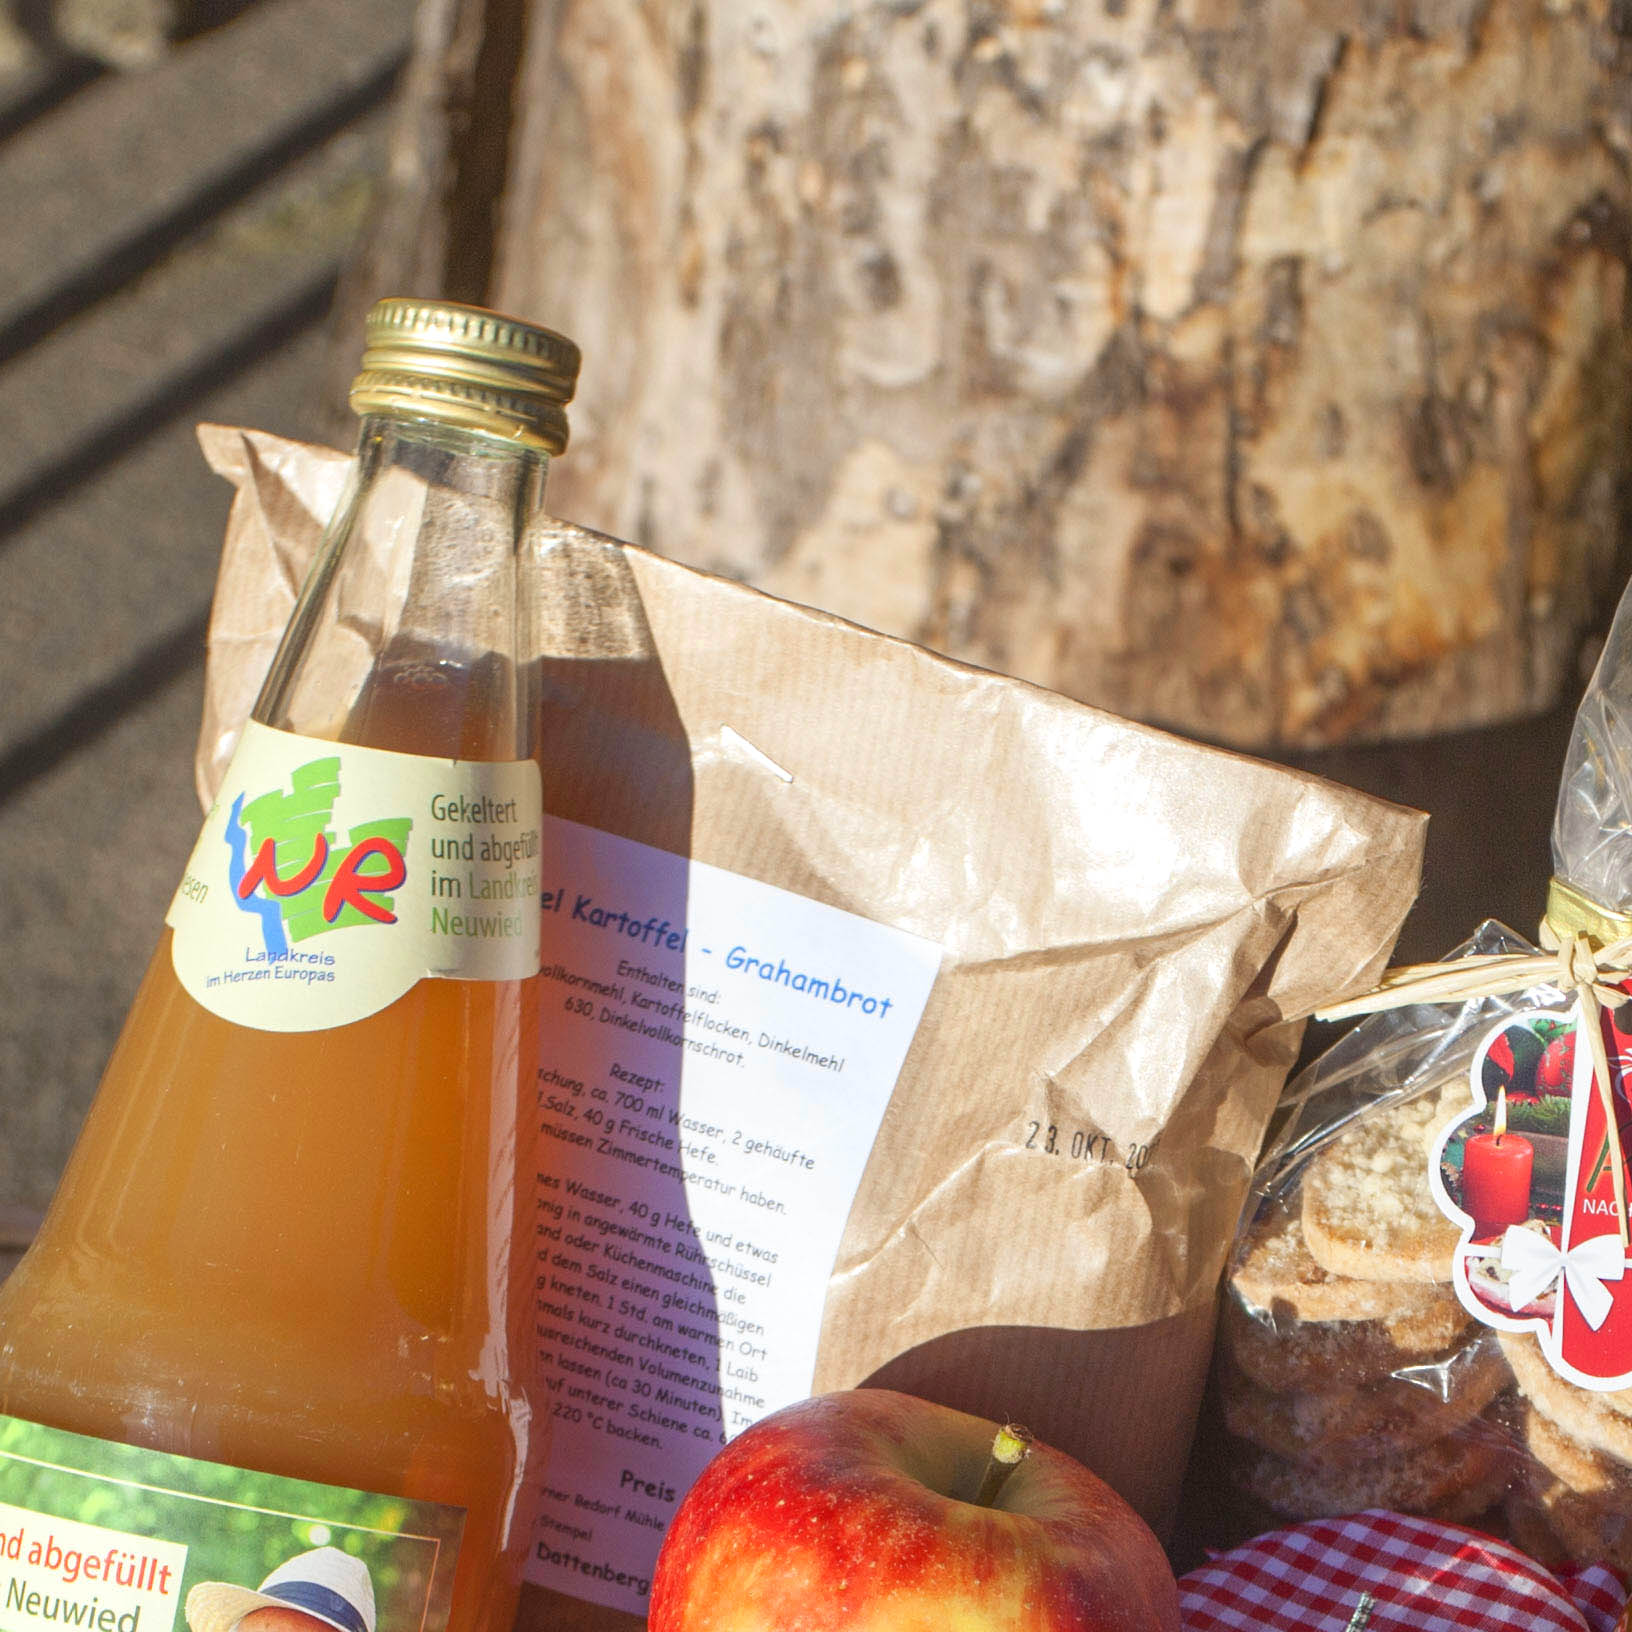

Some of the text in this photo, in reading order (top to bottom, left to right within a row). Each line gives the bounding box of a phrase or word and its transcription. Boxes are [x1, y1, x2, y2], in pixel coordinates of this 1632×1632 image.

[431, 794, 519, 824] Gekeltert
[431, 832, 474, 862] und
[431, 869, 461, 898] im
[431, 906, 523, 938] Neuwied
[206, 965, 336, 988] im Herzen Europas
[245, 946, 336, 966] Landkreis
[572, 894, 894, 1019] Kartoffel Grahambrot
[617, 960, 722, 1005] Enthalten sind:
[564, 996, 595, 1021] 630,
[630, 990, 753, 1046] Kartoffelflocken,
[757, 1030, 846, 1074] Dinkelmehl
[609, 1062, 665, 1094] Rezept:
[582, 1107, 604, 1127] 40
[605, 1118, 616, 1134] g
[618, 1118, 674, 1151] Frische
[615, 1091, 644, 1114] 700
[645, 1104, 666, 1121] ml
[731, 1130, 743, 1147] 2
[746, 1137, 816, 1172] gehäufte
[596, 1136, 737, 1197] Zimmertemperatur
[740, 1187, 788, 1216] haben.
[567, 1205, 581, 1221] in
[584, 1211, 672, 1255] angewärmte
[628, 1200, 649, 1219] 40
[651, 1210, 662, 1227] g
[664, 1211, 702, 1239] Hefe
[705, 1230, 734, 1248] und
[735, 1239, 779, 1265] etwas
[564, 1229, 747, 1305] oder Küchenmaschine die
[551, 1252, 583, 1274] dem
[586, 1261, 618, 1286] Salz
[621, 1277, 660, 1301] einen
[662, 1291, 765, 1336] gleichmäßigen
[578, 1307, 610, 1334] kurz
[726, 1361, 759, 1383] Laib
[618, 1300, 648, 1323] Std.
[652, 1314, 674, 1332] am
[677, 1324, 735, 1353] warmen
[739, 1340, 769, 1361] Ort
[557, 1353, 602, 1382] lassen
[631, 1379, 652, 1397] 30
[638, 1355, 766, 1409] Volumenzunahme
[552, 1401, 583, 1424] 220
[606, 1418, 664, 1450] backen.
[568, 1384, 625, 1412] unterer
[627, 1403, 689, 1435] Schiene
[619, 1468, 677, 1503] Preis
[624, 1508, 666, 1533] Mühle
[27, 1534, 173, 1596] abgefüllt
[536, 1540, 652, 1596] Dattenberg
